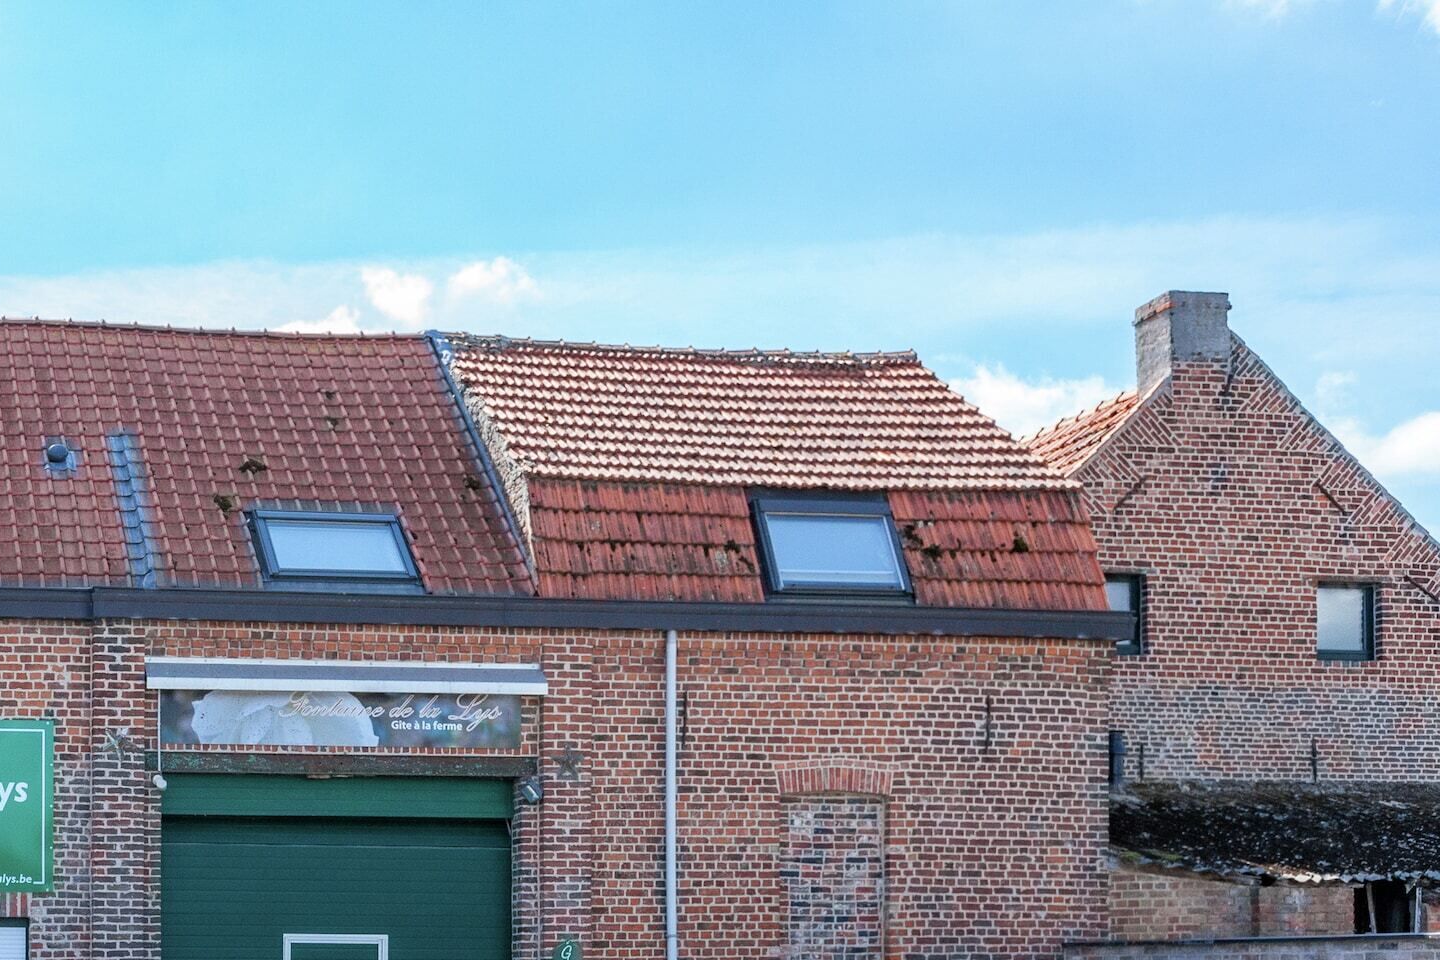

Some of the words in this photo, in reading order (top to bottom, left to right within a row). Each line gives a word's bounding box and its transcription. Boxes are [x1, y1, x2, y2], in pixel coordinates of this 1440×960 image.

[388, 694, 414, 718] de
[418, 695, 442, 719] la
[447, 693, 503, 733] Lys
[413, 720, 421, 731] à
[421, 720, 431, 731] la
[432, 720, 463, 731] ferme
